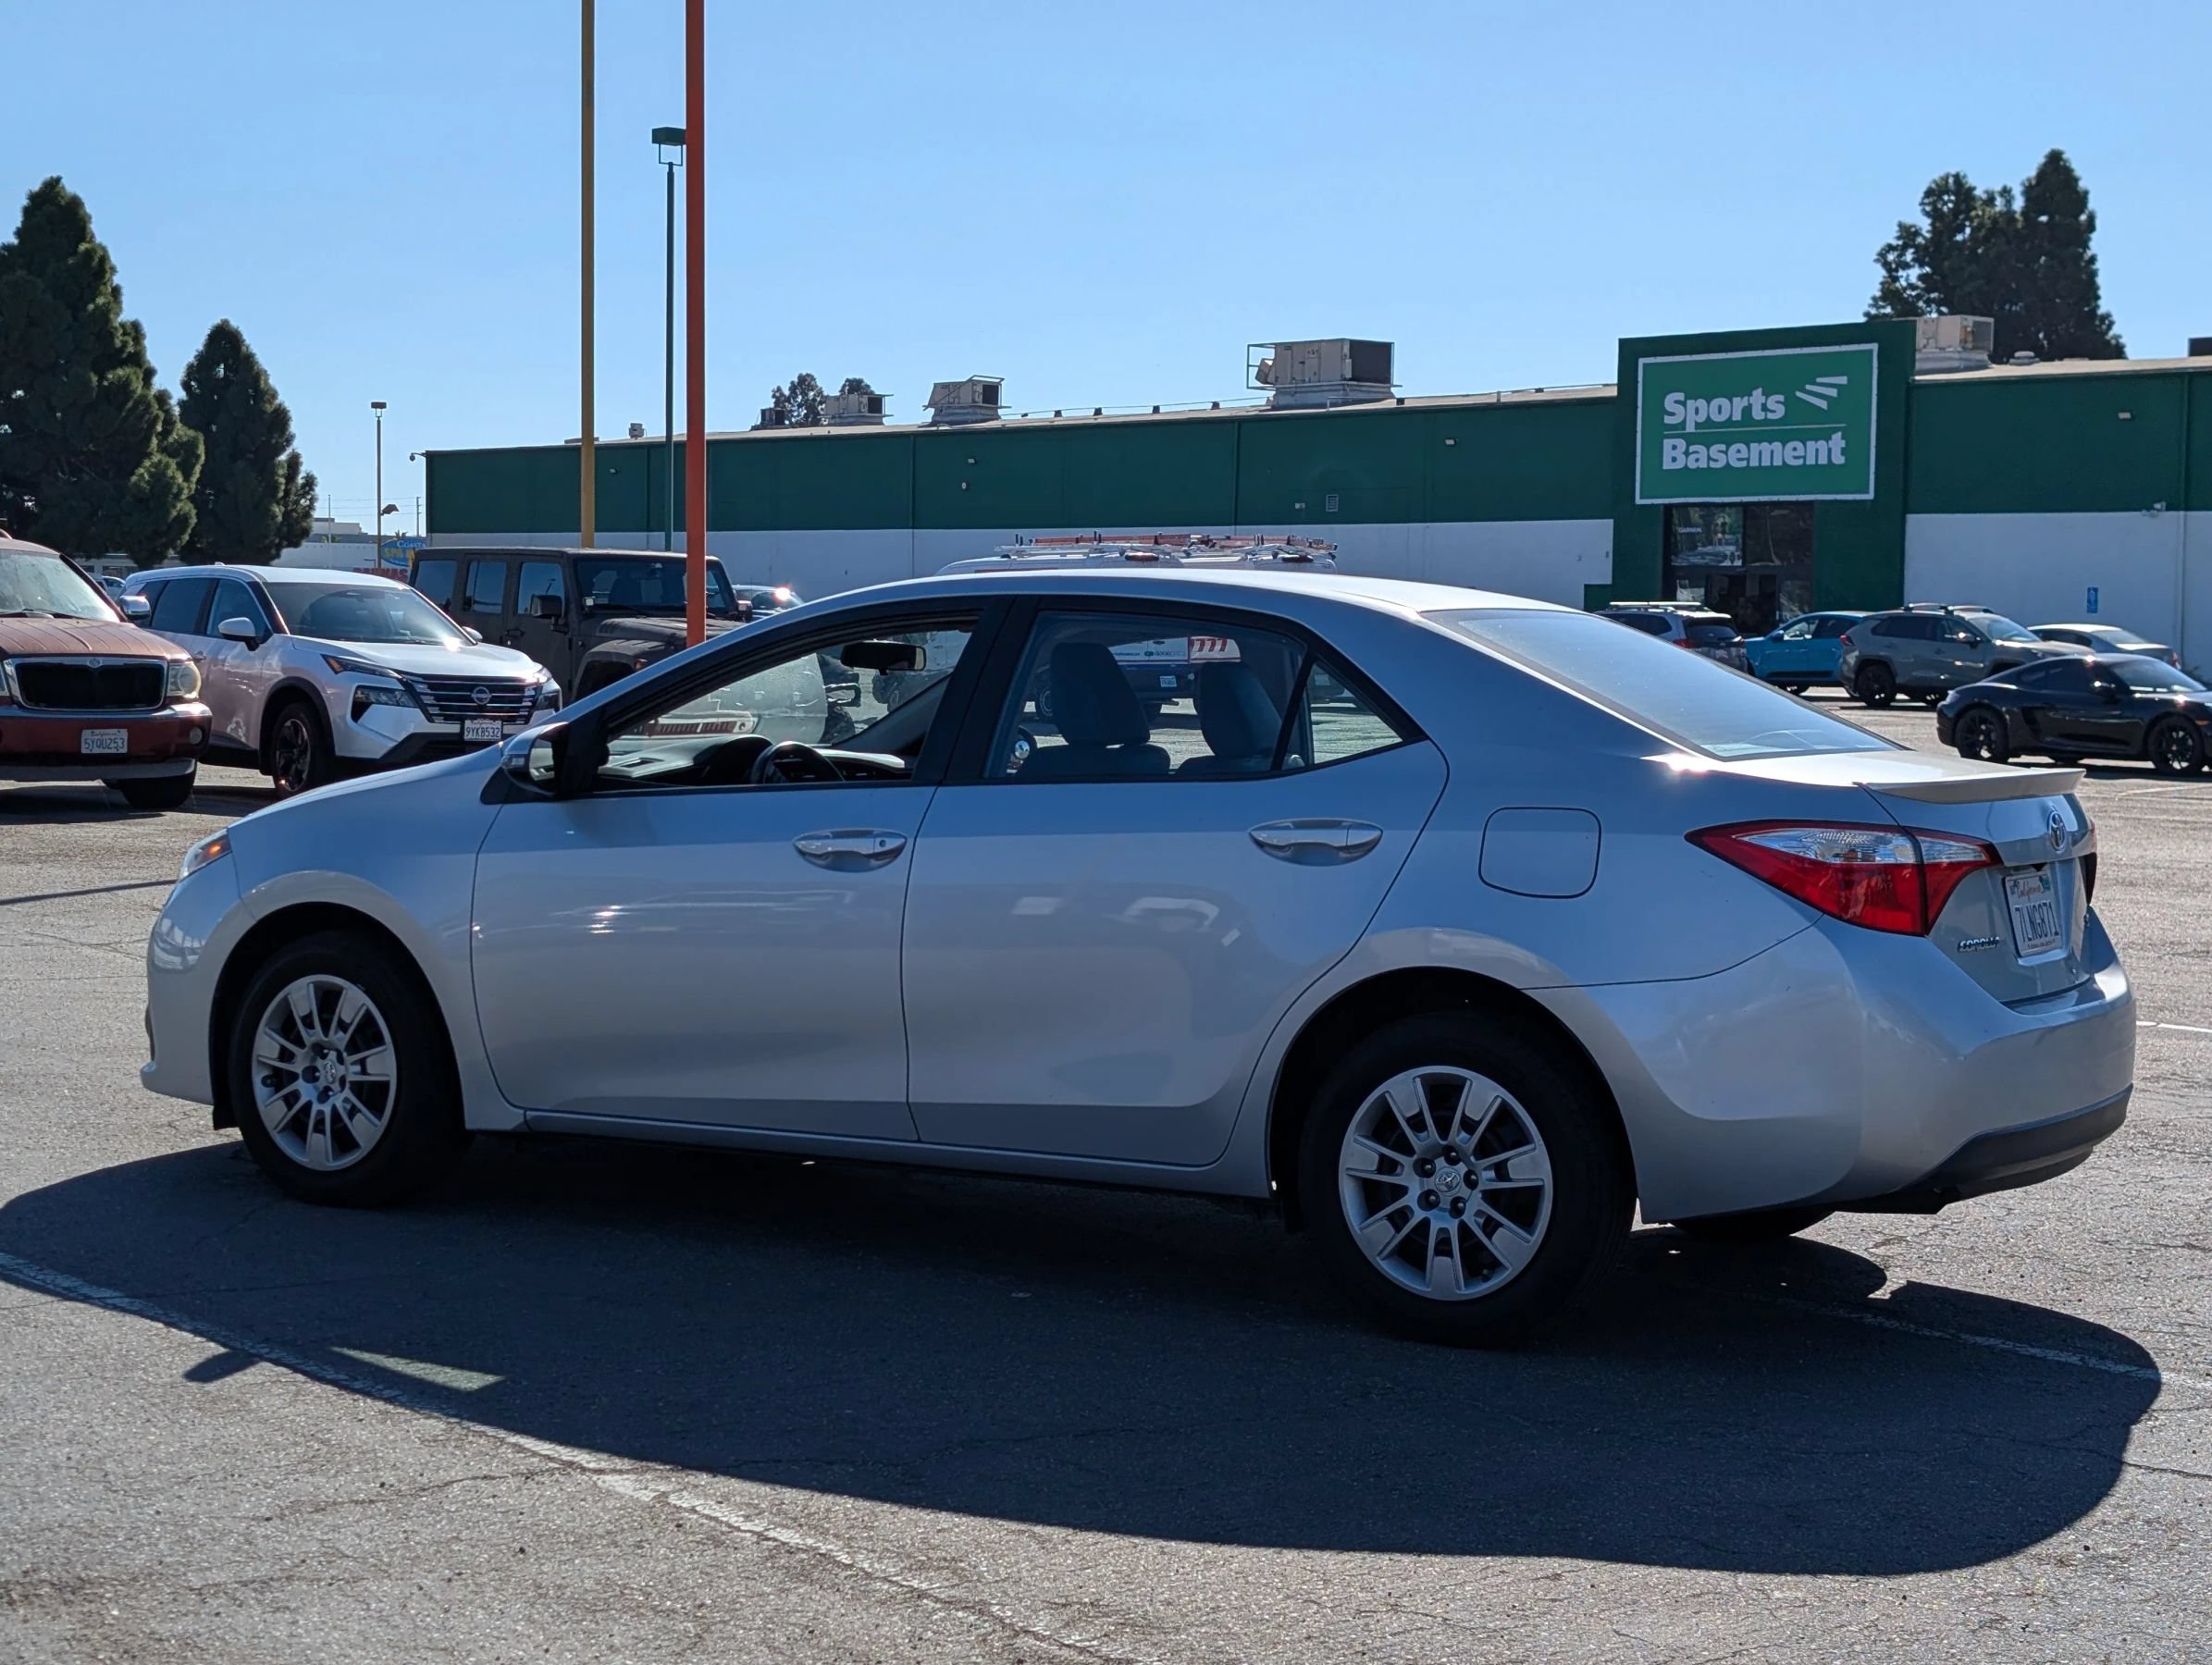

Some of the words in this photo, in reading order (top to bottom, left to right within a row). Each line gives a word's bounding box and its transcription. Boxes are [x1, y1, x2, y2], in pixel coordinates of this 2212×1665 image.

[1663, 388, 1786, 432] Sports
[1662, 431, 1846, 470] Basement
[465, 726, 500, 738] 9YKB532
[2014, 900, 2060, 944] 7LNG871
[1958, 936, 2000, 952] COROLLA
